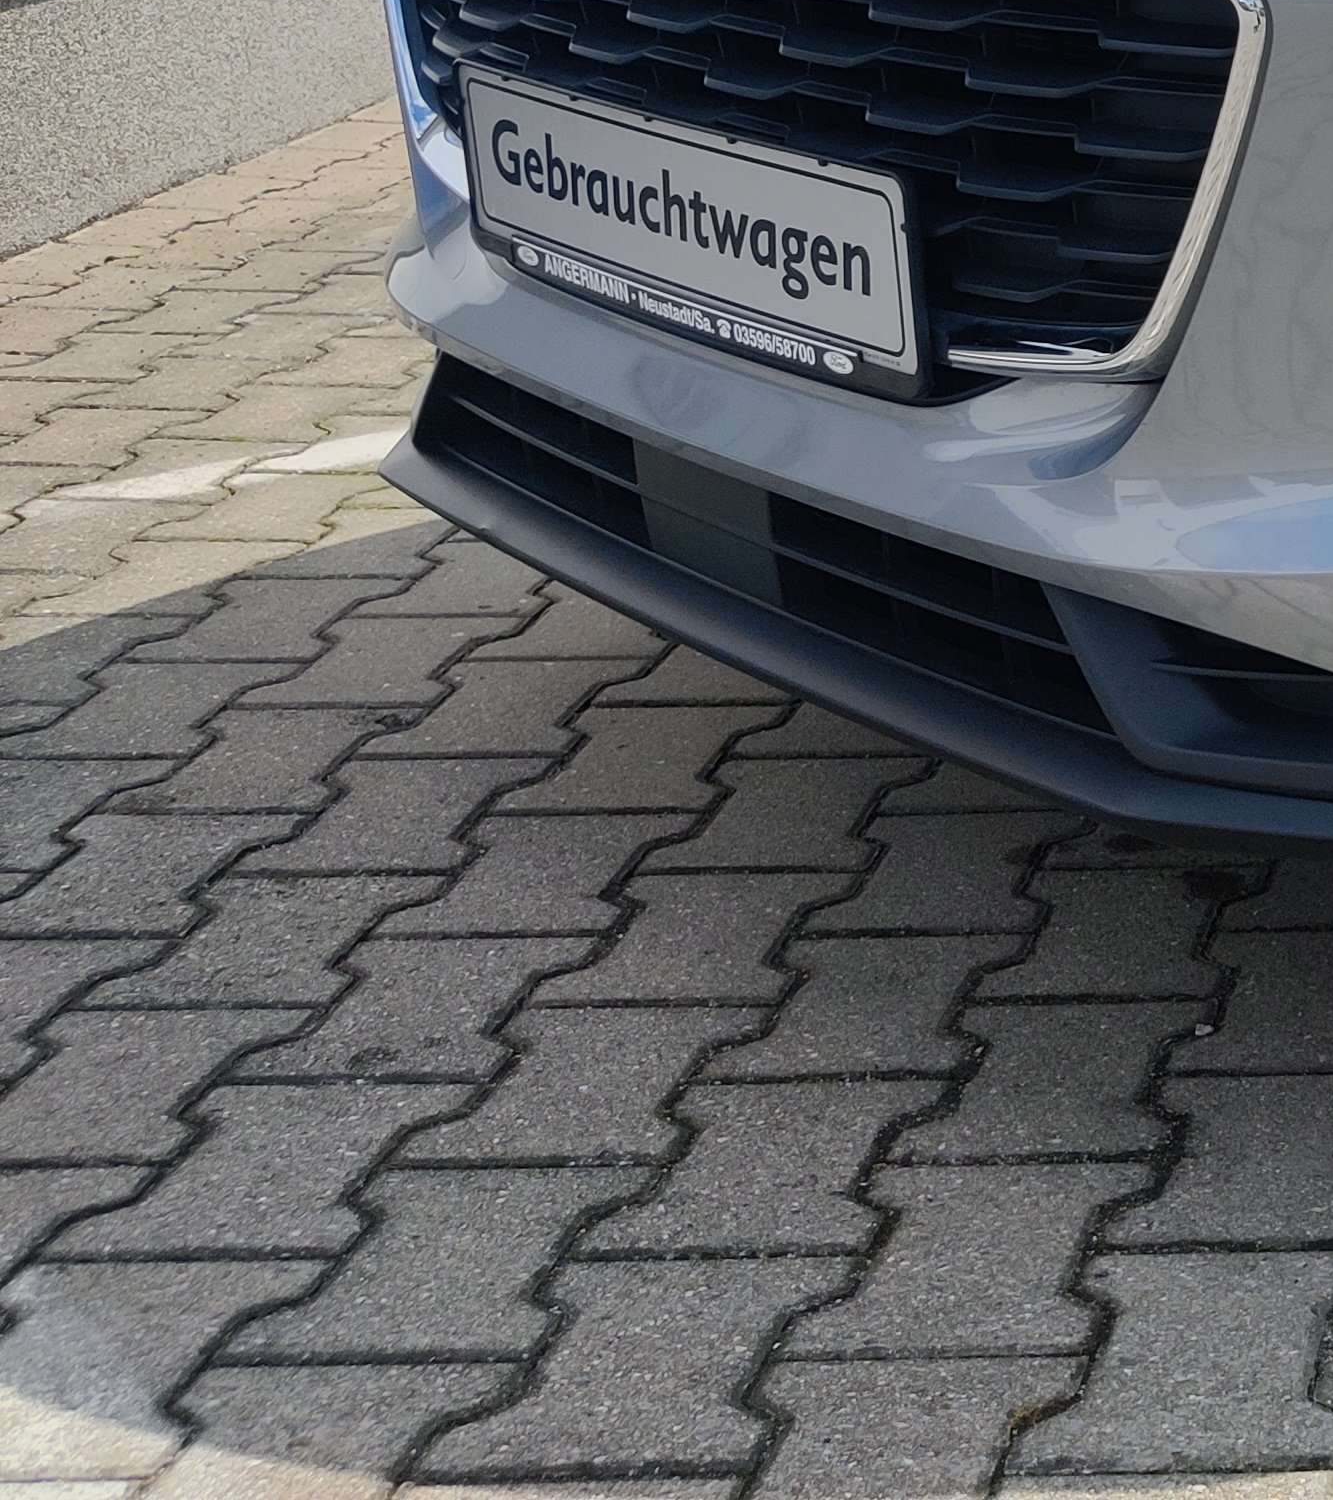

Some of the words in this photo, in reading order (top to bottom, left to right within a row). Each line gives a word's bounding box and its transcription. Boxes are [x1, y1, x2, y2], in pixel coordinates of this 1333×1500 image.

[491, 119, 872, 301] Gebrauchtwagen
[544, 253, 630, 304] ANGERMANN
[638, 290, 716, 335] Neustadt/Sa.
[733, 323, 816, 367] 03596/58700
